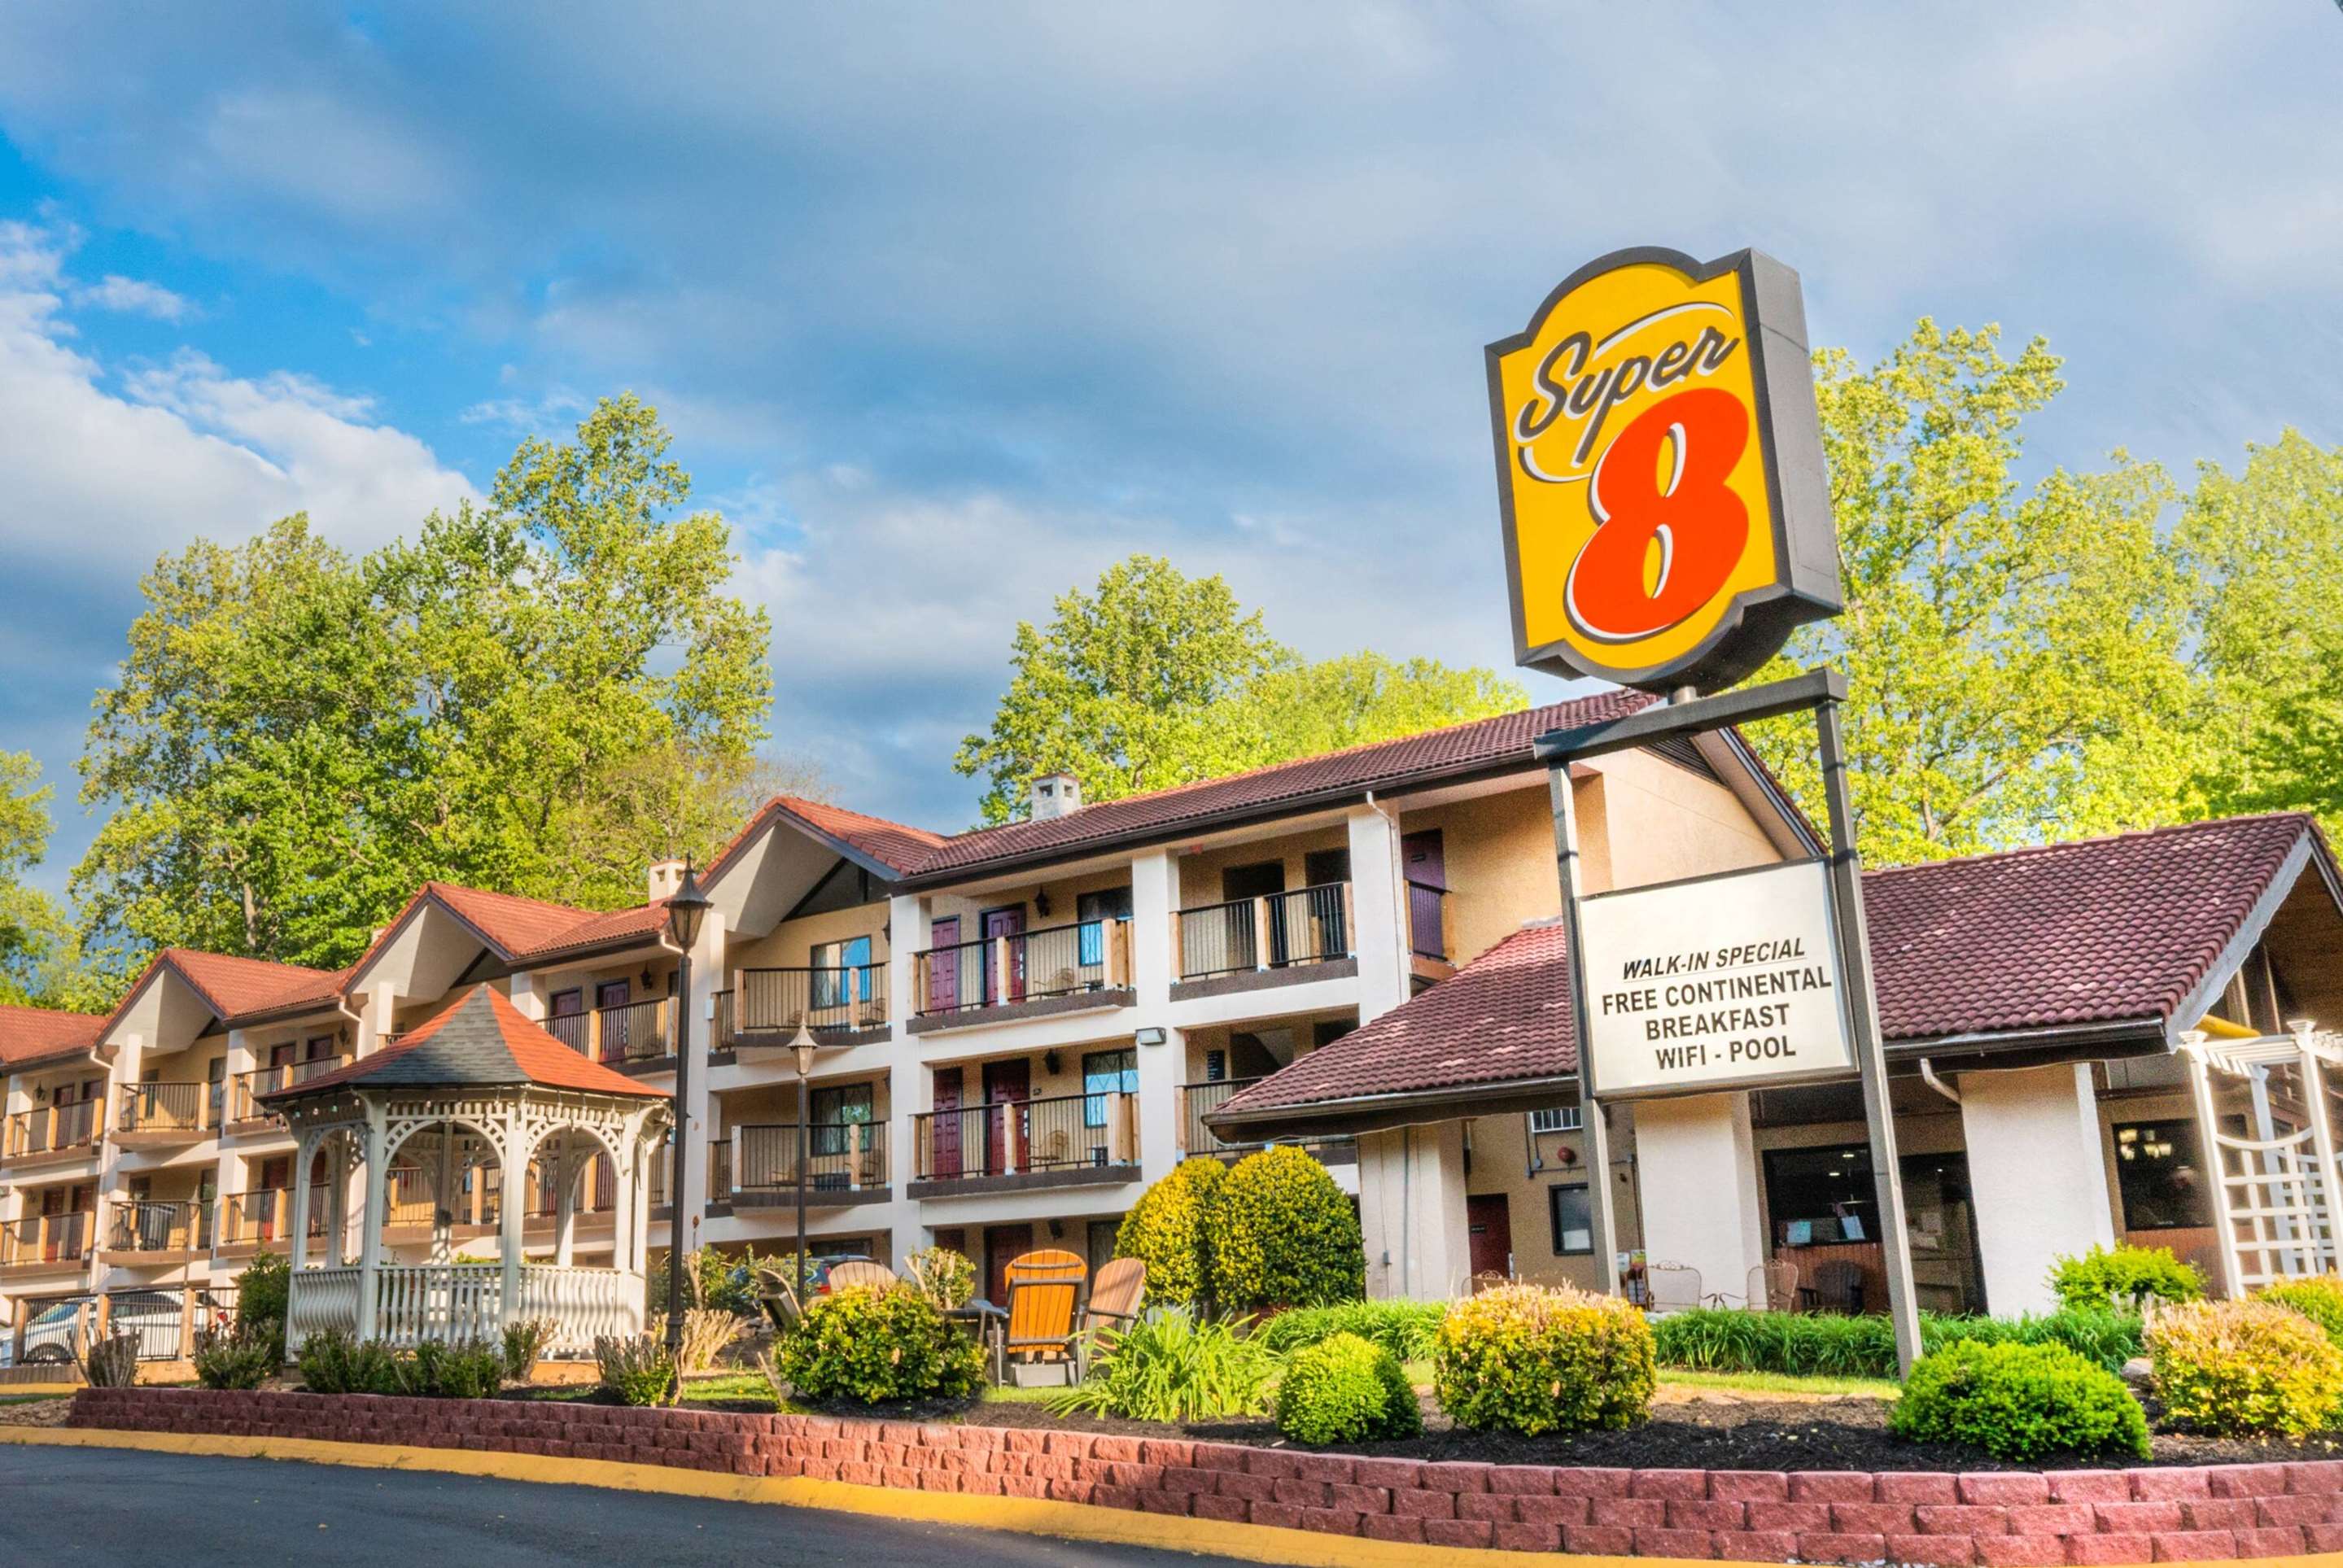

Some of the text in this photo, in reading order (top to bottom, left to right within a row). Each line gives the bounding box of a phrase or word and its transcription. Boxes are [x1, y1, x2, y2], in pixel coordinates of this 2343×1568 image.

[1515, 325, 1740, 467] Super
[1564, 387, 1750, 644] 8
[1623, 937, 1806, 980] WALK-IN SPECIAL
[1602, 966, 1832, 1015] FREE CONTINENTAL
[1646, 1003, 1790, 1041] BREAKFAST
[1655, 1044, 1707, 1070] WIFI
[1729, 1035, 1796, 1062] POOL
